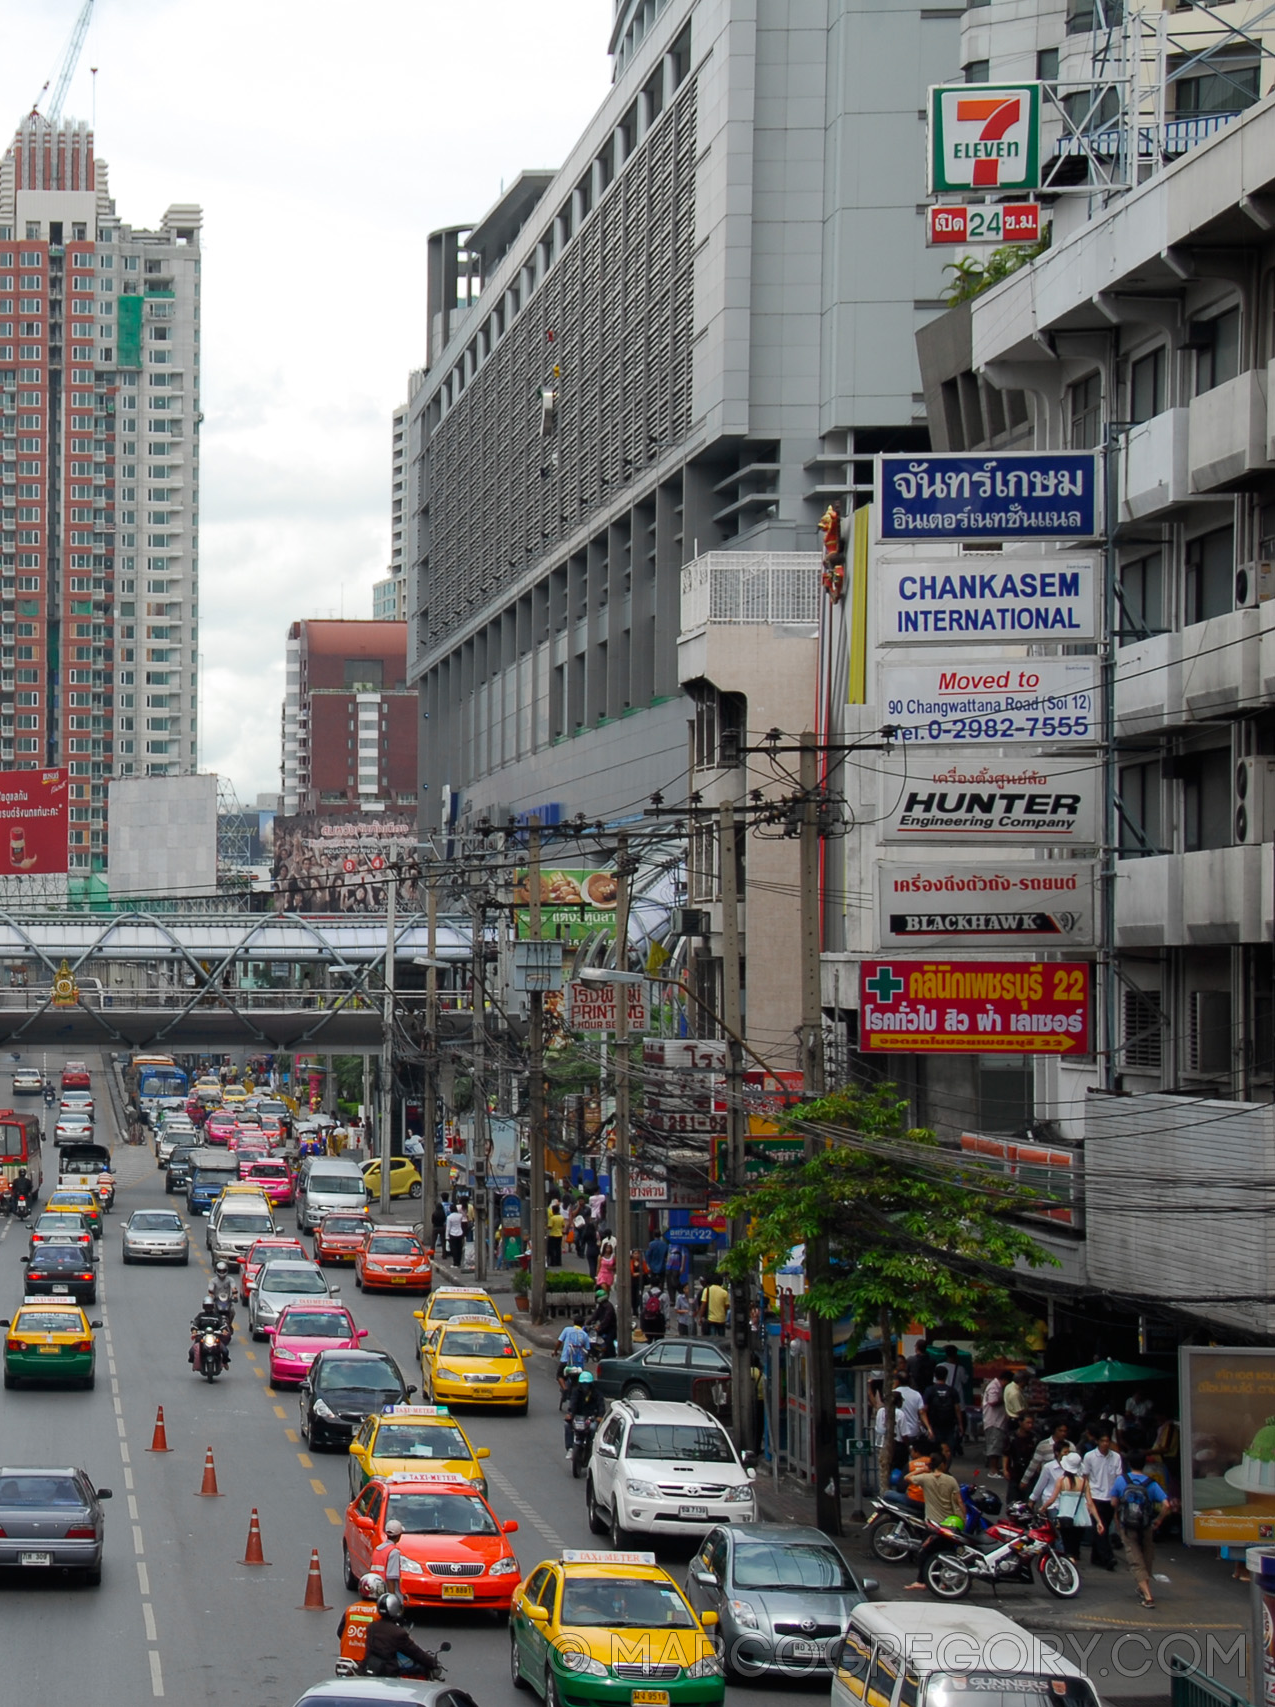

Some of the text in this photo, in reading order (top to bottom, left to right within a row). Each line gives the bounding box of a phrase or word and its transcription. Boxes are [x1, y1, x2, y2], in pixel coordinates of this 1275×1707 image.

[935, 213, 964, 231] เปิด
[969, 212, 1001, 236] 24
[893, 461, 1083, 499] จันทร์เกษม
[899, 573, 1080, 601] CHANKASEM
[897, 607, 1080, 632] INTERNATIONAL
[938, 671, 1040, 690] Moved to
[888, 694, 1091, 717] 90 Changwattana Road (Soi 12)
[892, 715, 1089, 741] Tel. 0-2982-7555
[903, 793, 1081, 815] HUNTER
[899, 815, 1075, 830] Engineering Company
[905, 914, 1038, 932] BLACKHAWK
[909, 964, 1084, 1011] คลินิกเพชรบุรี 22
[571, 1004, 644, 1019] PRINTNG
[865, 1002, 937, 1031] โรคทั่วไป
[944, 1008, 969, 1031] สิว
[1010, 1009, 1083, 1033] เลเซอร์
[577, 1020, 603, 1029] HOUR
[1040, 1038, 1064, 1047] 22
[699, 1230, 713, 1240] 22
[969, 1677, 1048, 1689] GUNNERS
[975, 1685, 1047, 1694] ARSENAL
